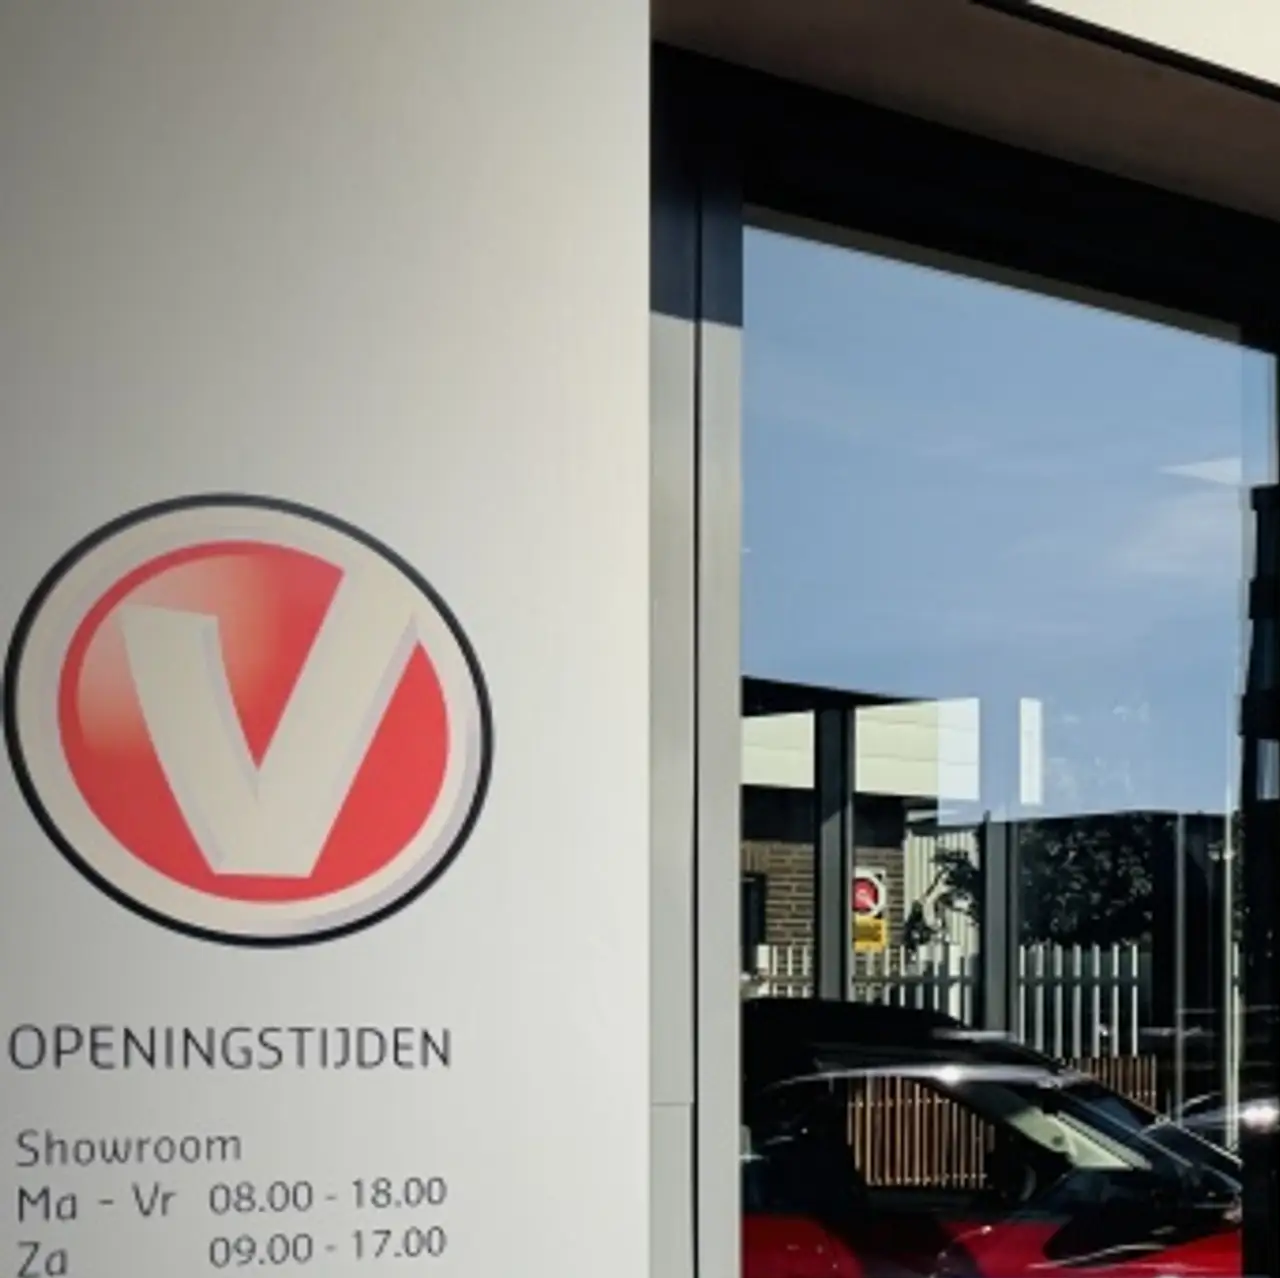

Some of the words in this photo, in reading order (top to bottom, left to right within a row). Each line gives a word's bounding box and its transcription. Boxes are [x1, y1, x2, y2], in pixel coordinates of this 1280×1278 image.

[118, 555, 418, 878] V
[8, 1023, 452, 1071] OPENINGSTIJDEN
[15, 1128, 242, 1168] Showroom
[17, 1185, 78, 1223] Ma
[131, 1181, 177, 1218] Vr
[208, 1179, 315, 1216] 08.00
[351, 1175, 448, 1210] 18.00
[208, 1232, 315, 1269] 09.00
[351, 1224, 448, 1260] 17.00
